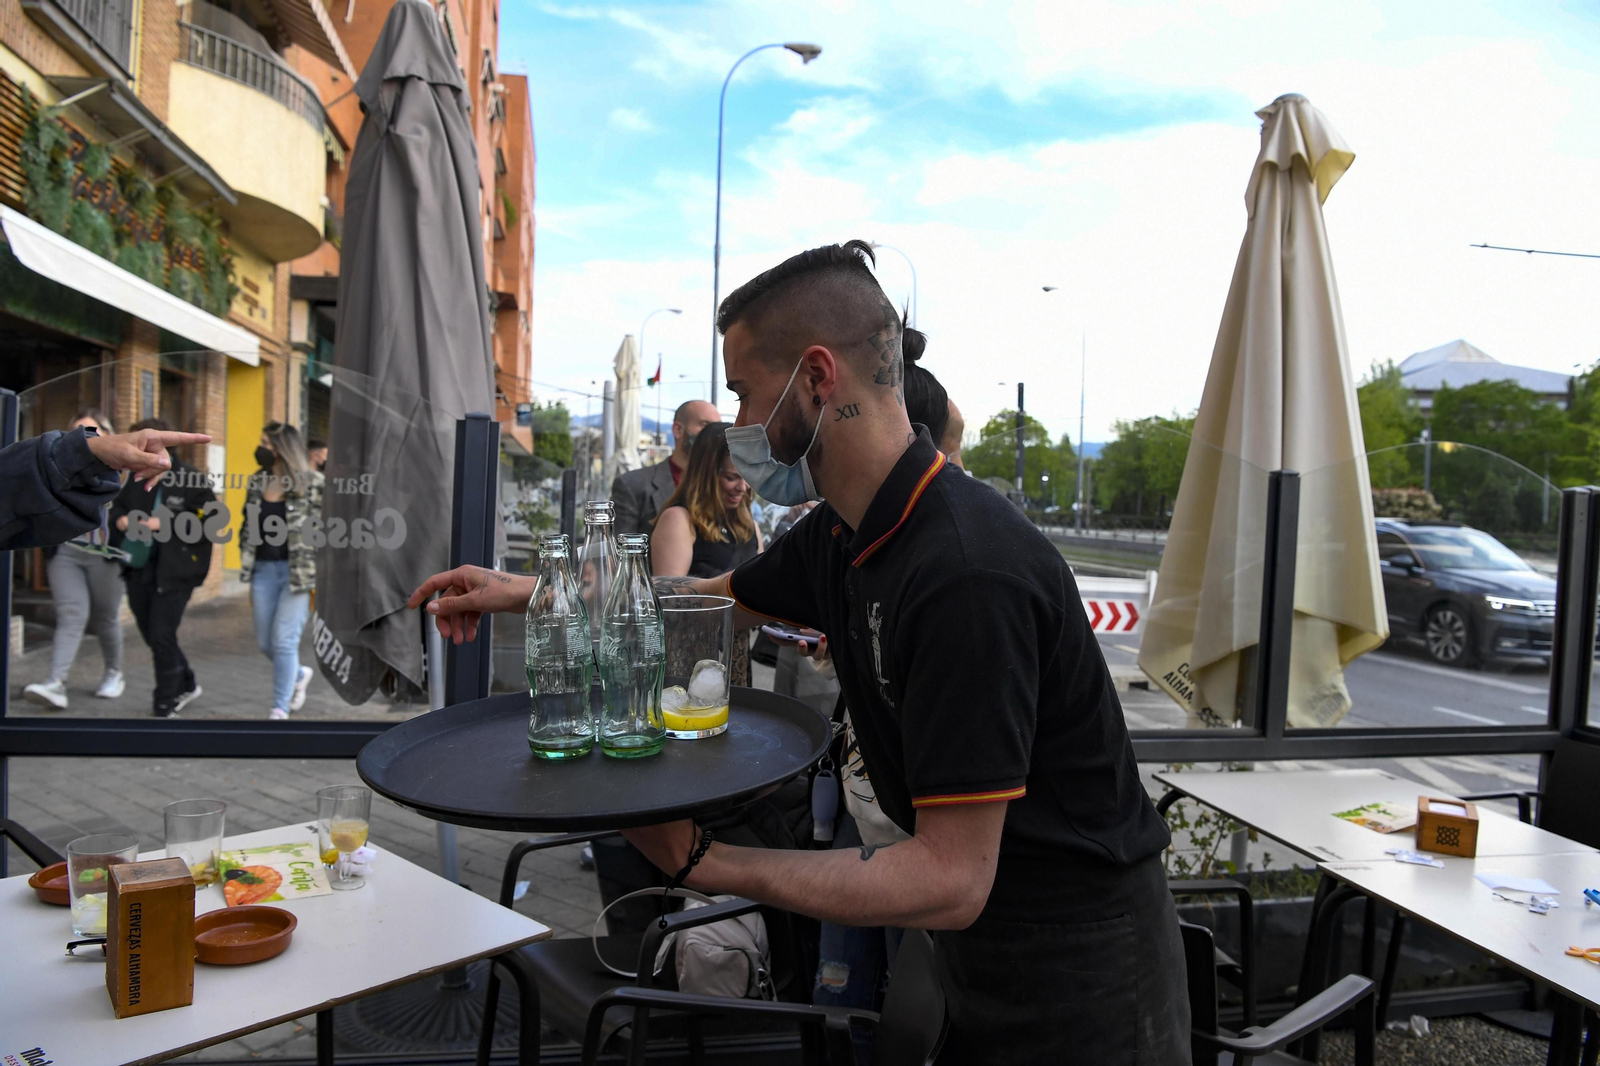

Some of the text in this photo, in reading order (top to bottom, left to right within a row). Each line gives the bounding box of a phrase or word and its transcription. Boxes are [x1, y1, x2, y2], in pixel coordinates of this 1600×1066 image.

[834, 403, 861, 421] XII
[128, 902, 141, 1007] CERVEZAS ALHAMBRA
